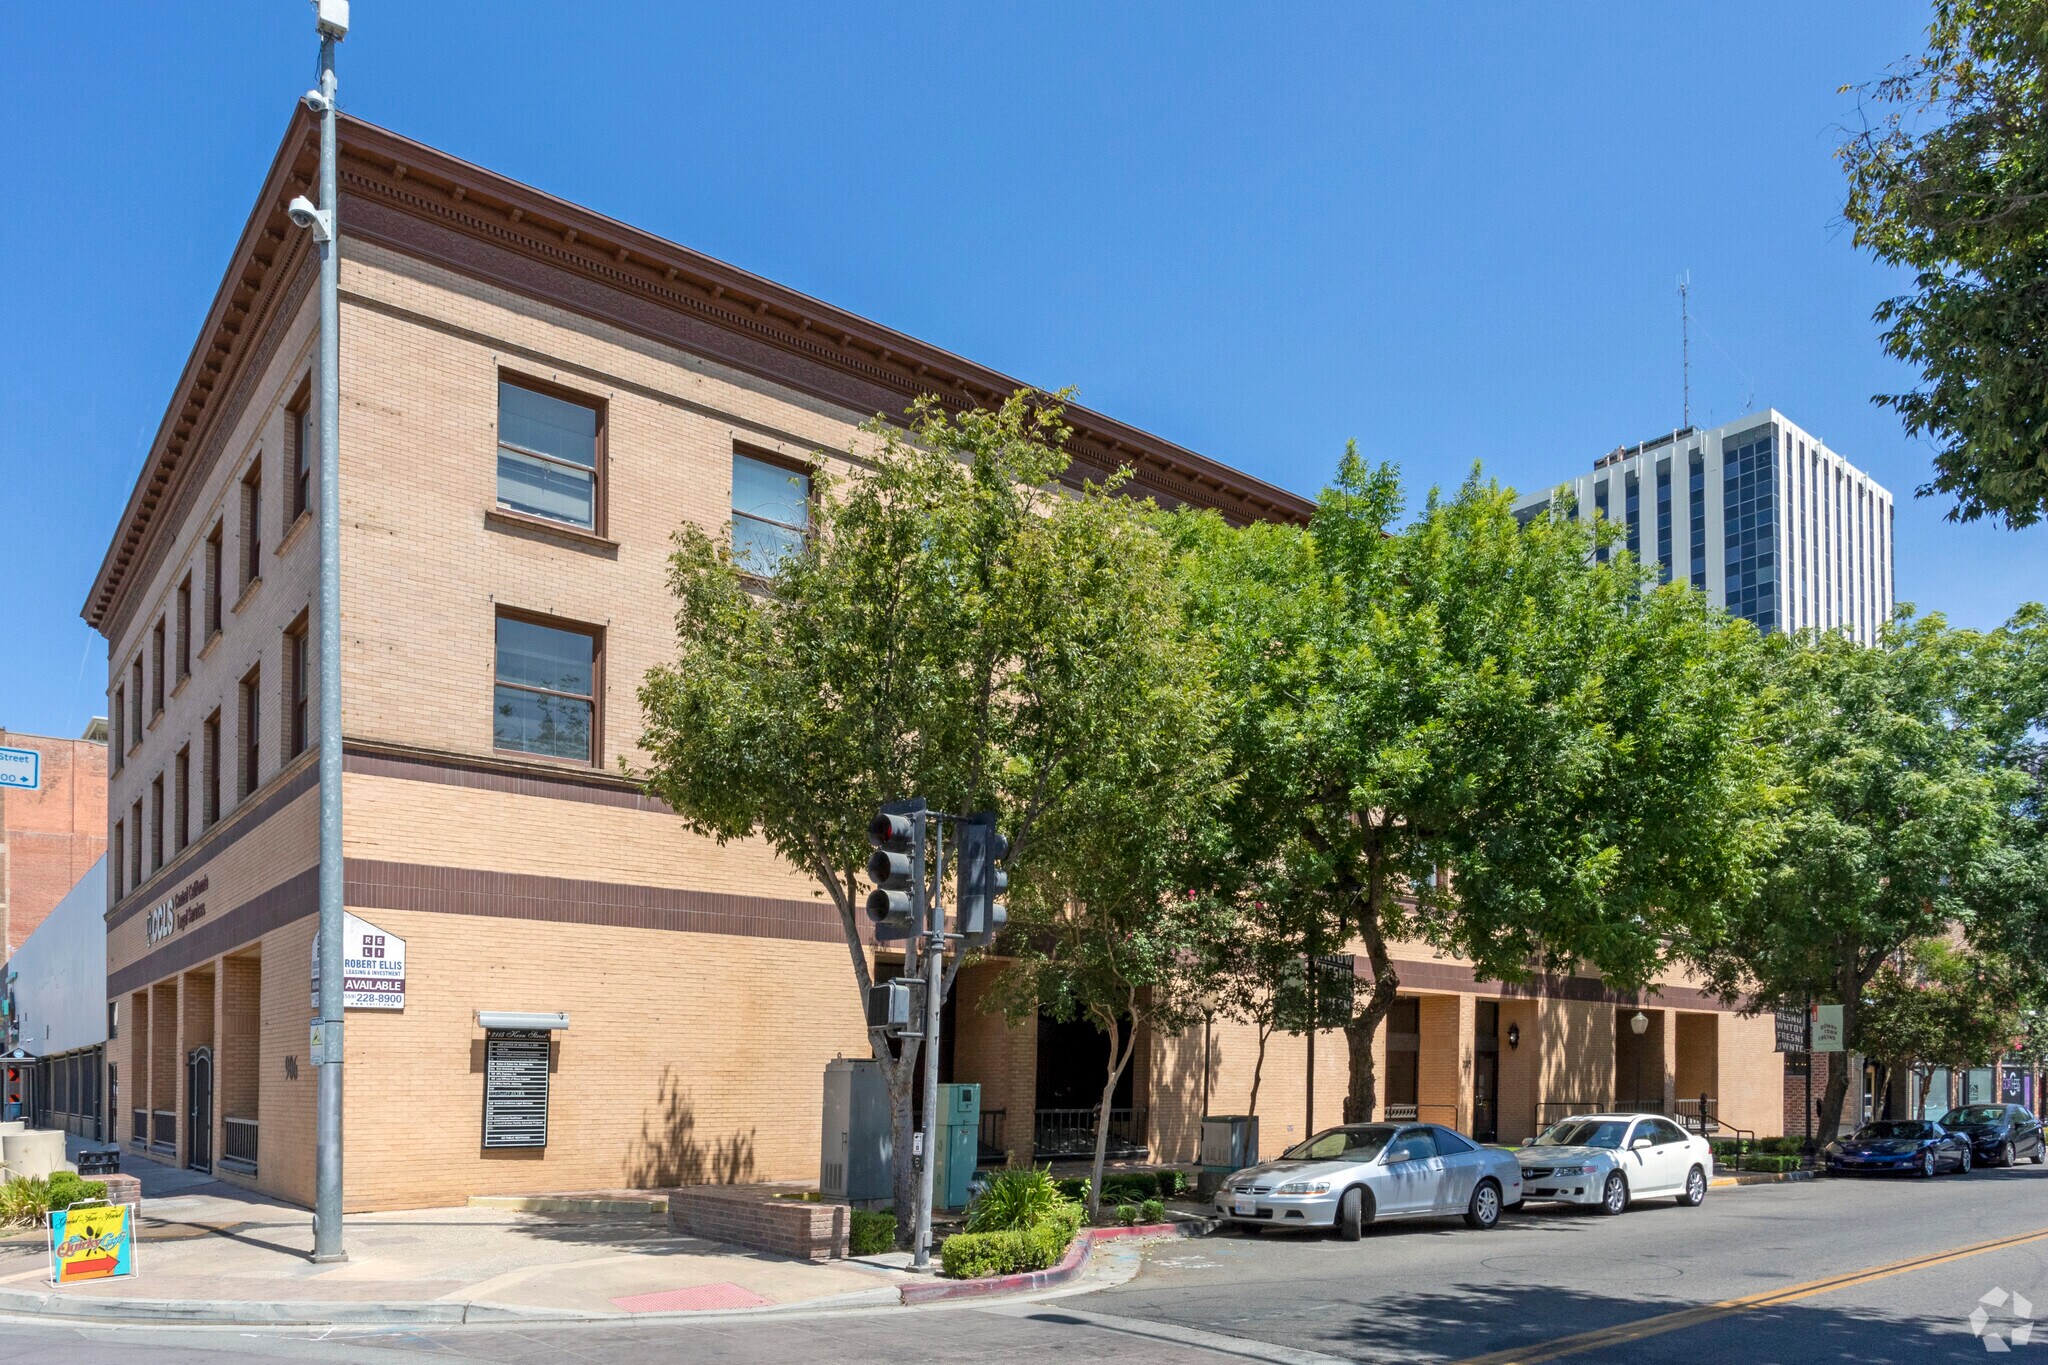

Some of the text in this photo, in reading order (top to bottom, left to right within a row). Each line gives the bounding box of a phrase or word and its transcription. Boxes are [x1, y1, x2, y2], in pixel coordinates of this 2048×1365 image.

[344, 959, 402, 970] ROBERT ELLIS
[345, 979, 401, 991] AVAILABLE
[356, 993, 402, 1003] 228-8900
[285, 1055, 298, 1080] 906
[56, 1236, 103, 1259] Quirky
